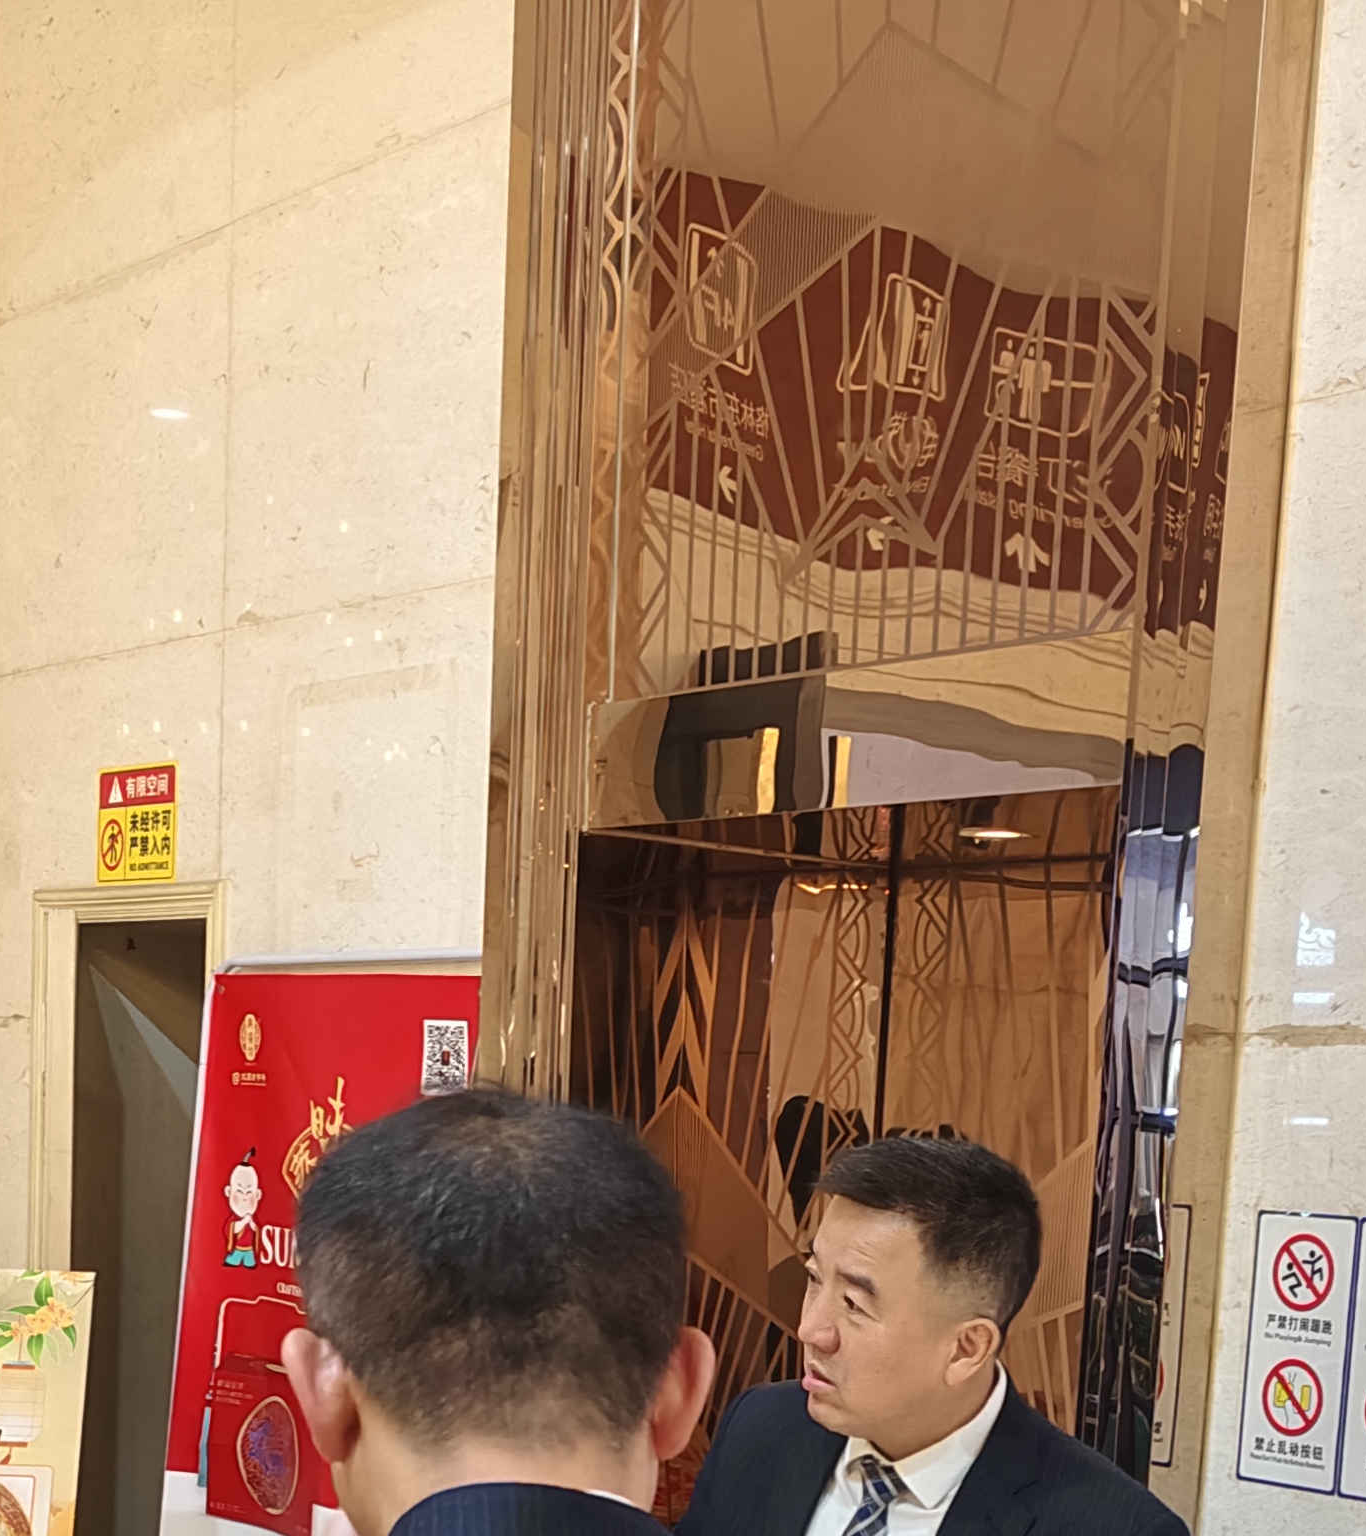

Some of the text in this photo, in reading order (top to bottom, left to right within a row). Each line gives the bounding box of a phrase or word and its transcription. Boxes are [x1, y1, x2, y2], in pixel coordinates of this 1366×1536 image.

[125, 773, 169, 799] 有限空间
[129, 809, 172, 834] 未经许可
[128, 833, 171, 858] 严禁入内
[1254, 1436, 1324, 1461] 禁止乱动按钮
